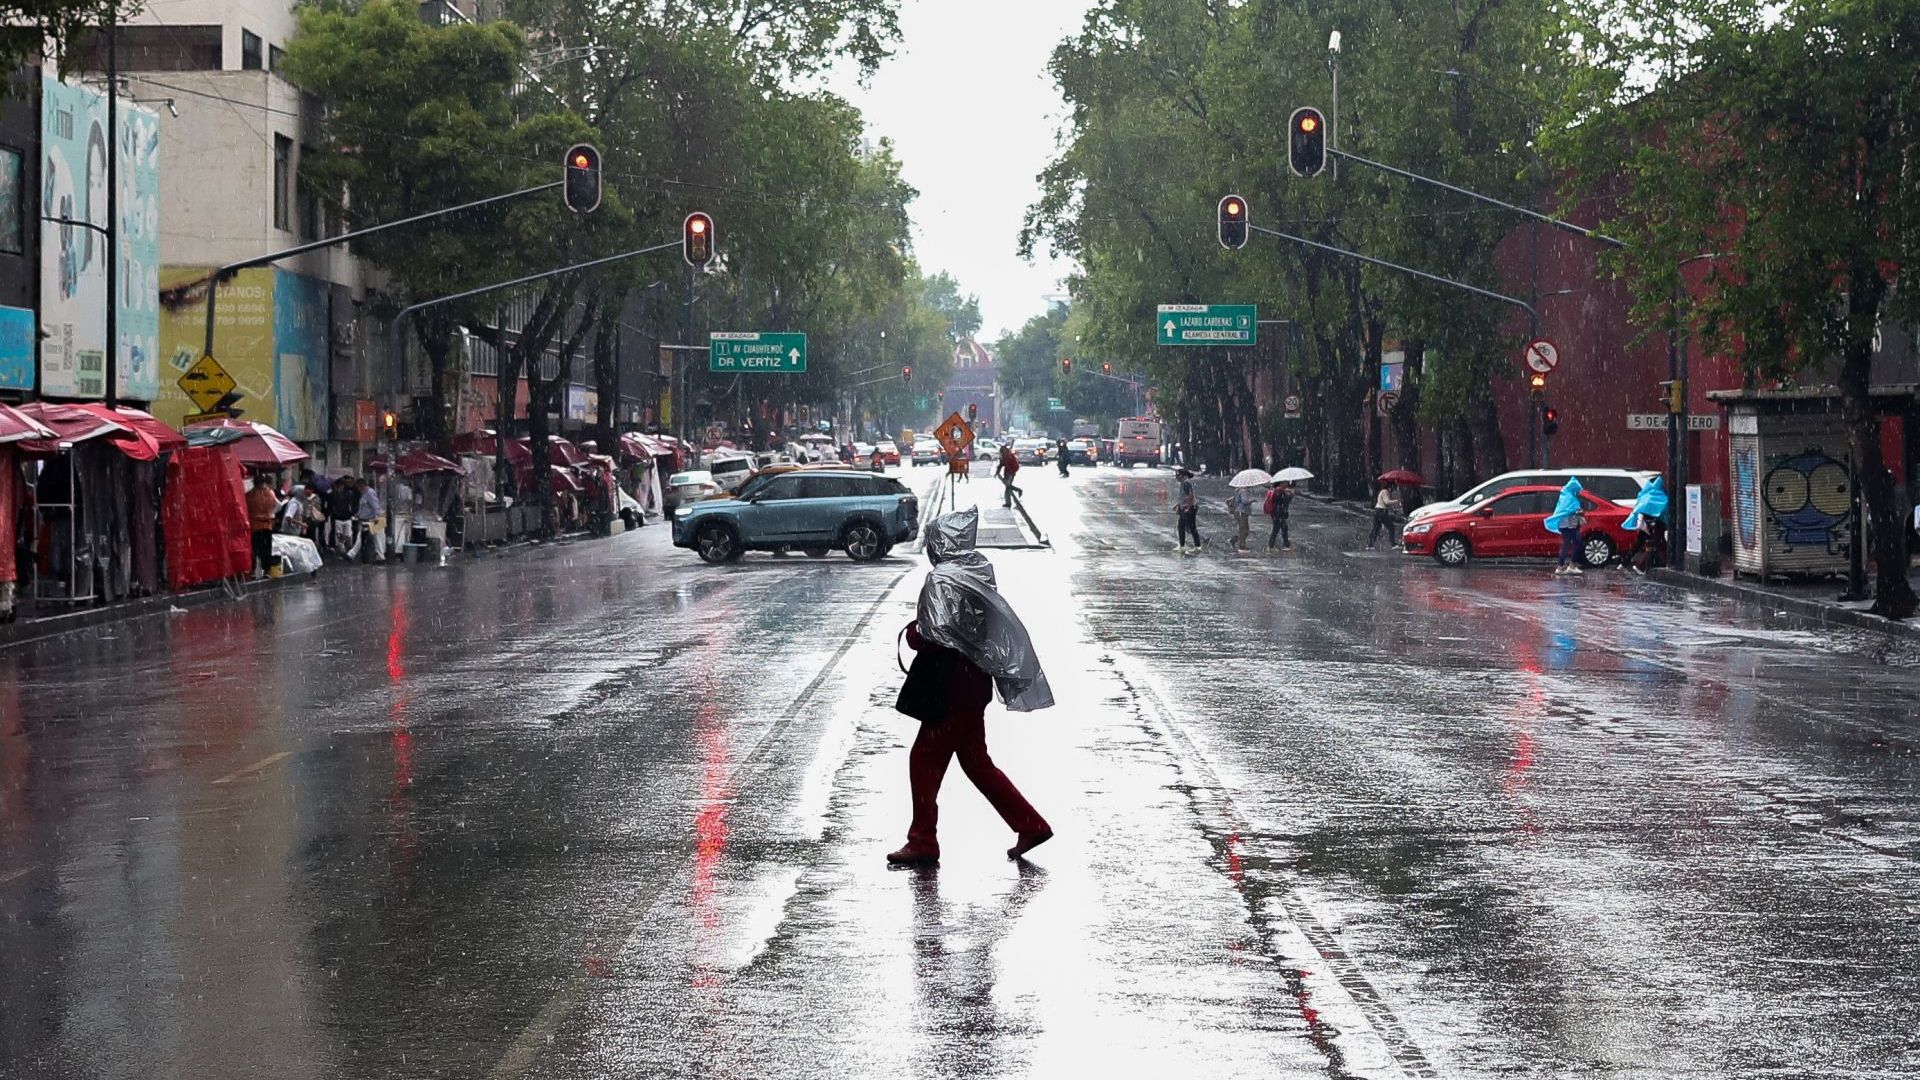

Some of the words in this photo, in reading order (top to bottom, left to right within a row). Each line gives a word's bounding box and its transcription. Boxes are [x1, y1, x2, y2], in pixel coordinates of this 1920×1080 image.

[1204, 317, 1233, 327] CARDENAS
[733, 344, 742, 354] AV
[743, 344, 784, 354] CUAUHTEMOC
[718, 357, 735, 367] DR
[740, 357, 781, 367] VERTIZ
[1634, 416, 1641, 427] 5
[1646, 416, 1659, 427] DE
